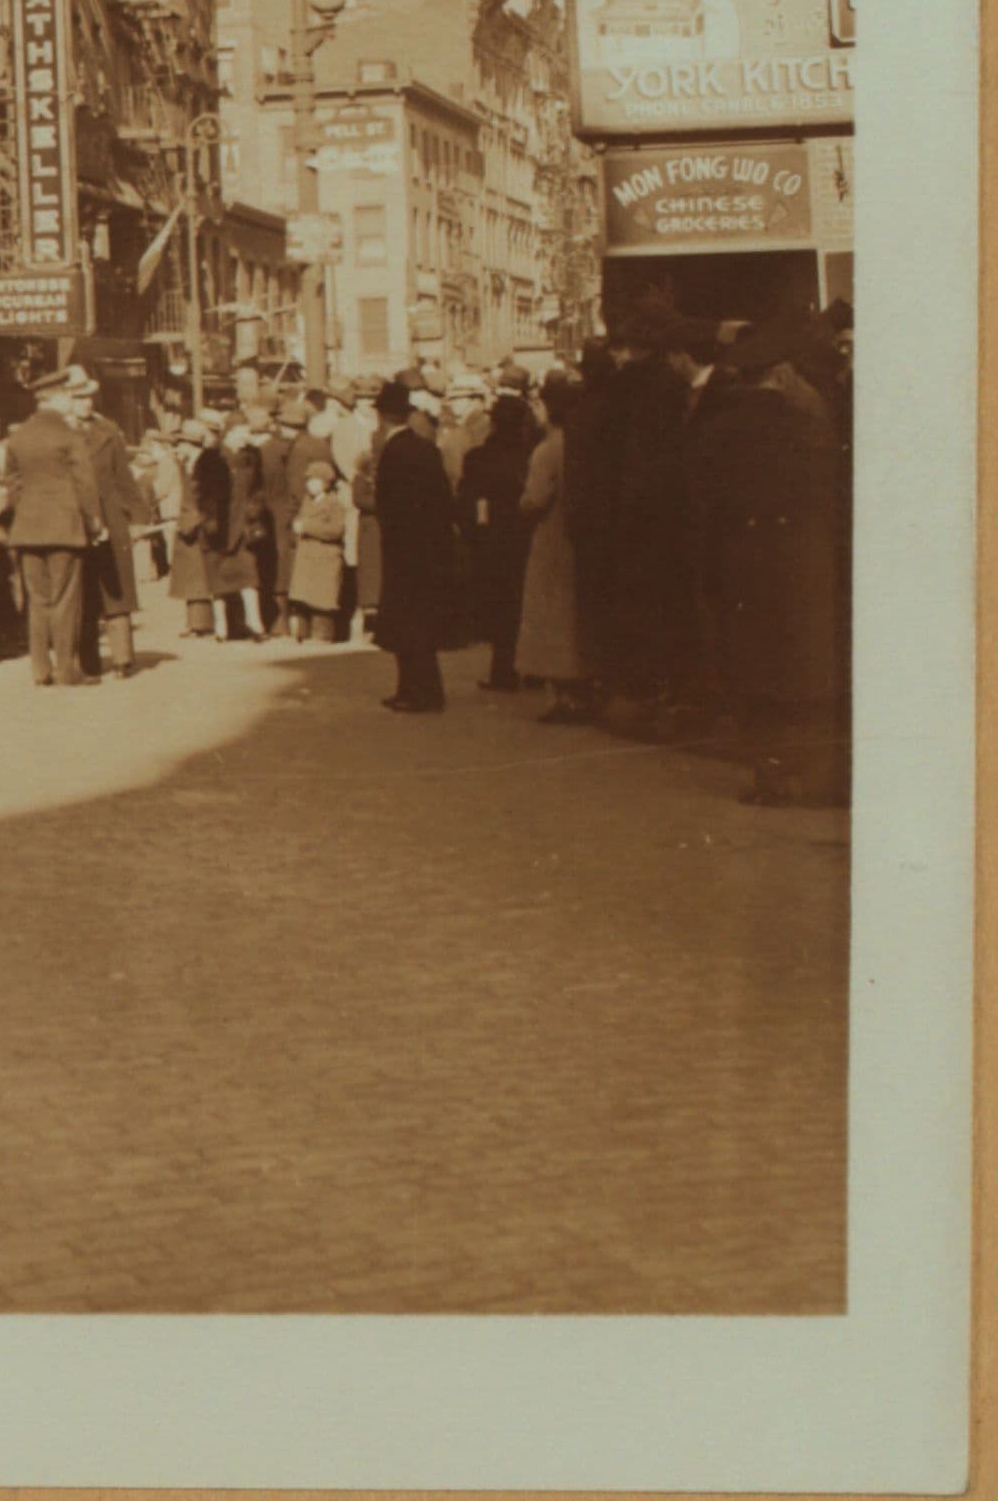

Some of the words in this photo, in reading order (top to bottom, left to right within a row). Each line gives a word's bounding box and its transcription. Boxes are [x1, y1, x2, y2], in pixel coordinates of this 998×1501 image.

[606, 60, 723, 101] YORK
[613, 165, 664, 207] MON
[666, 155, 729, 185] FONG
[733, 156, 770, 186] WO
[774, 170, 803, 197] CO
[654, 195, 765, 214] CHINESE
[656, 215, 766, 234] GROCERIES
